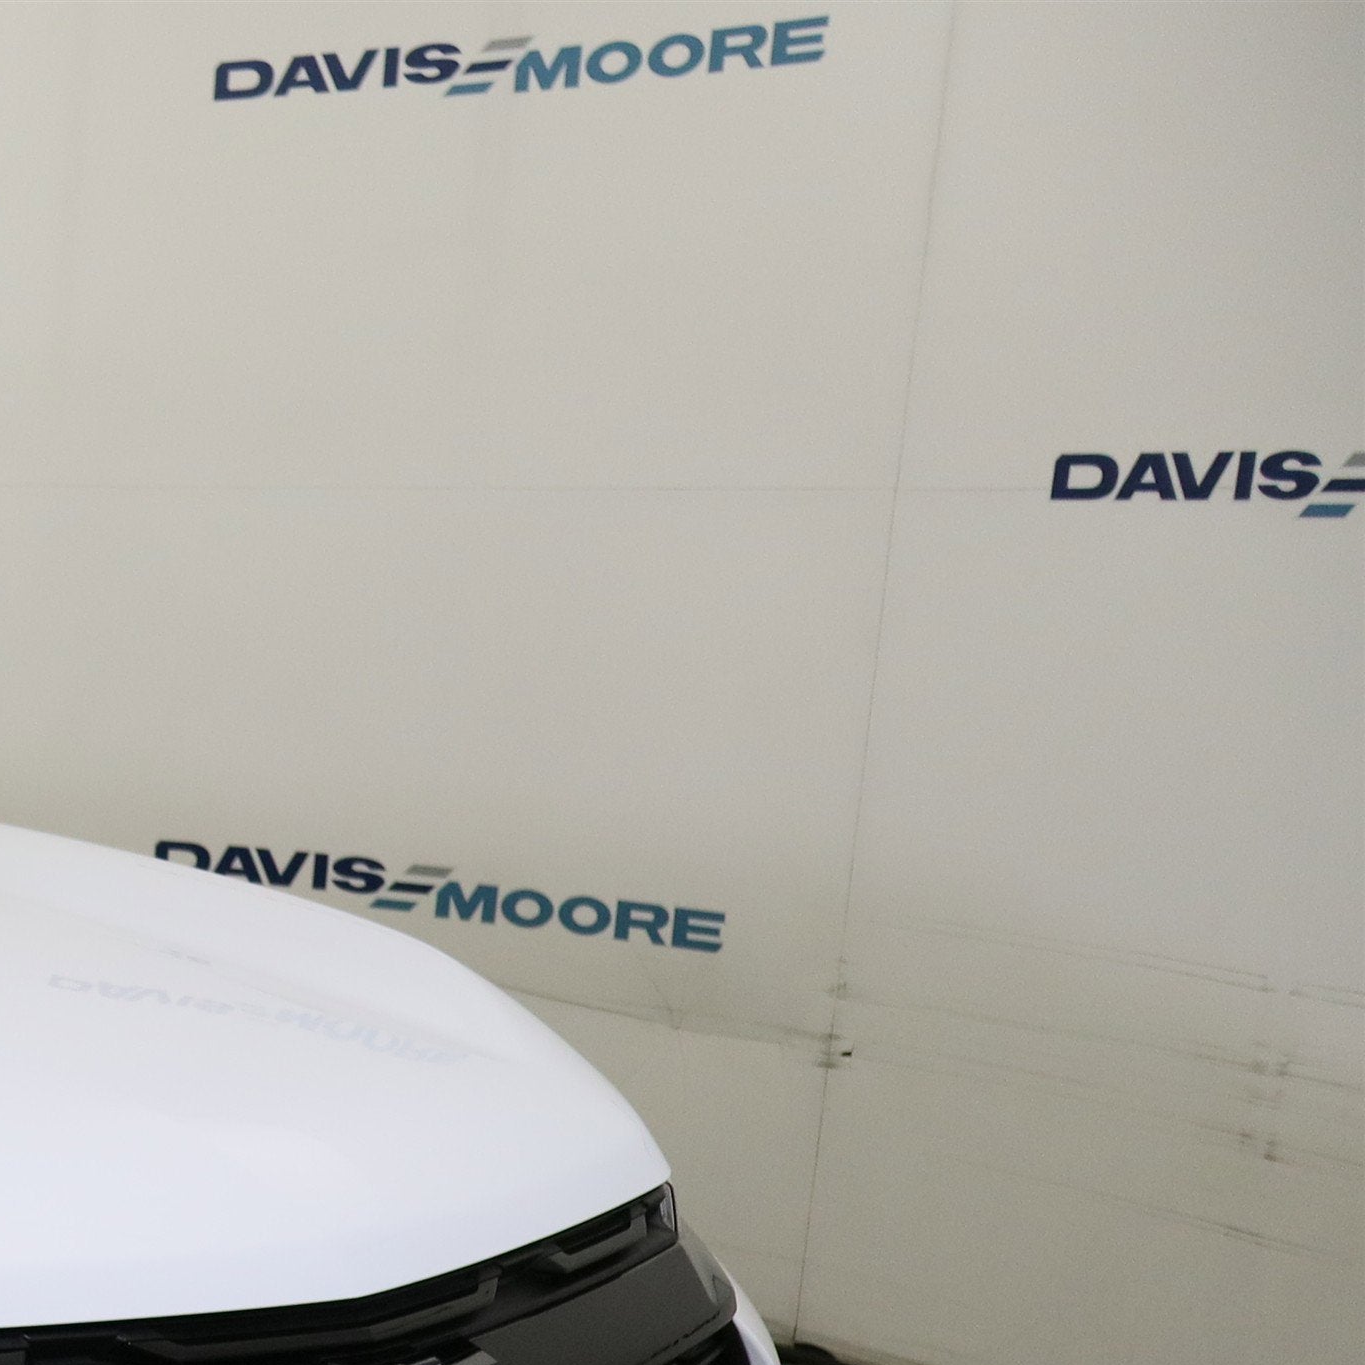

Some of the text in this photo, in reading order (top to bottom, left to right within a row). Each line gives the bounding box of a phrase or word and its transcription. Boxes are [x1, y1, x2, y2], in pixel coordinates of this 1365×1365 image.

[212, 14, 831, 101] DAVIS MOORE
[1049, 450, 1323, 501] DAVIS
[434, 880, 727, 953] MOORE
